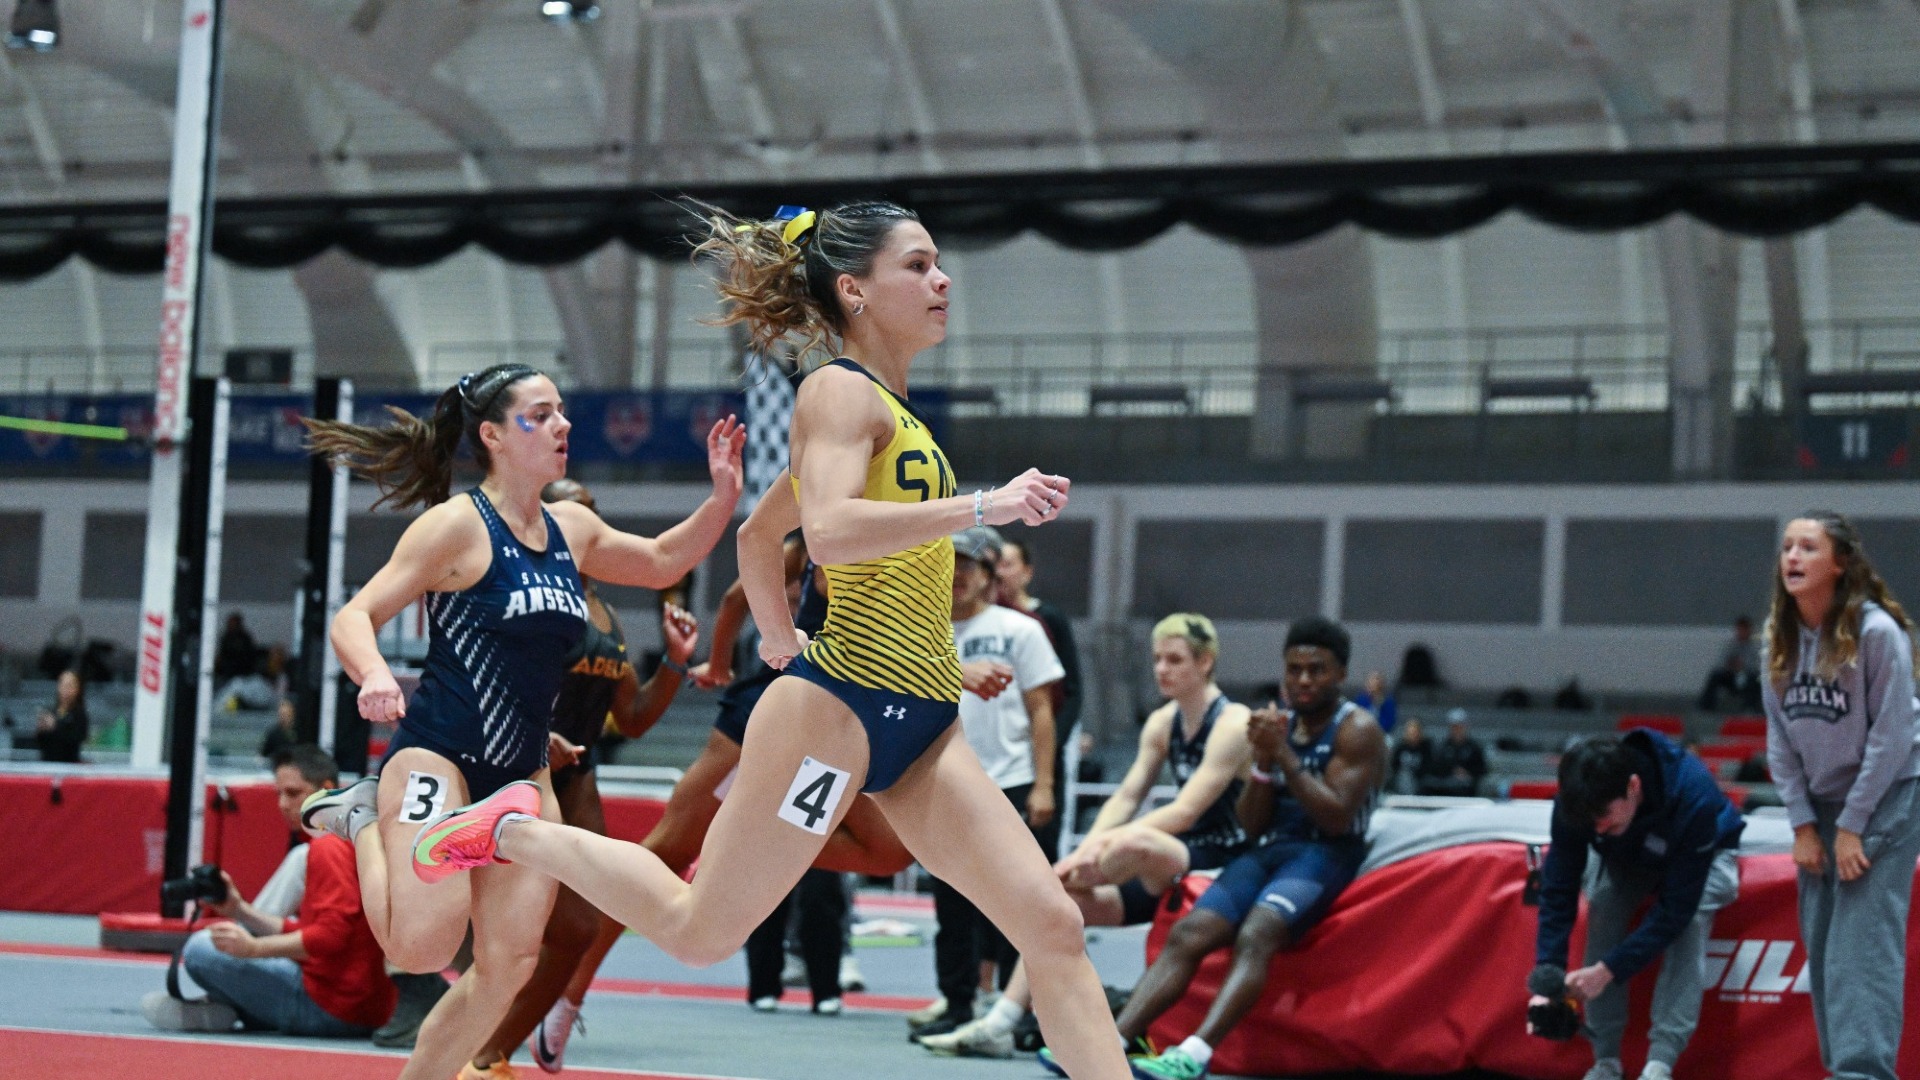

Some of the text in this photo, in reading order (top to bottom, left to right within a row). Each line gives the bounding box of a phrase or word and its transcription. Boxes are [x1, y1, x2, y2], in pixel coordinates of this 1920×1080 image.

[521, 572, 575, 592] SAINT
[142, 613, 164, 694] GILL
[408, 776, 439, 821] 3
[792, 771, 837, 829] 4
